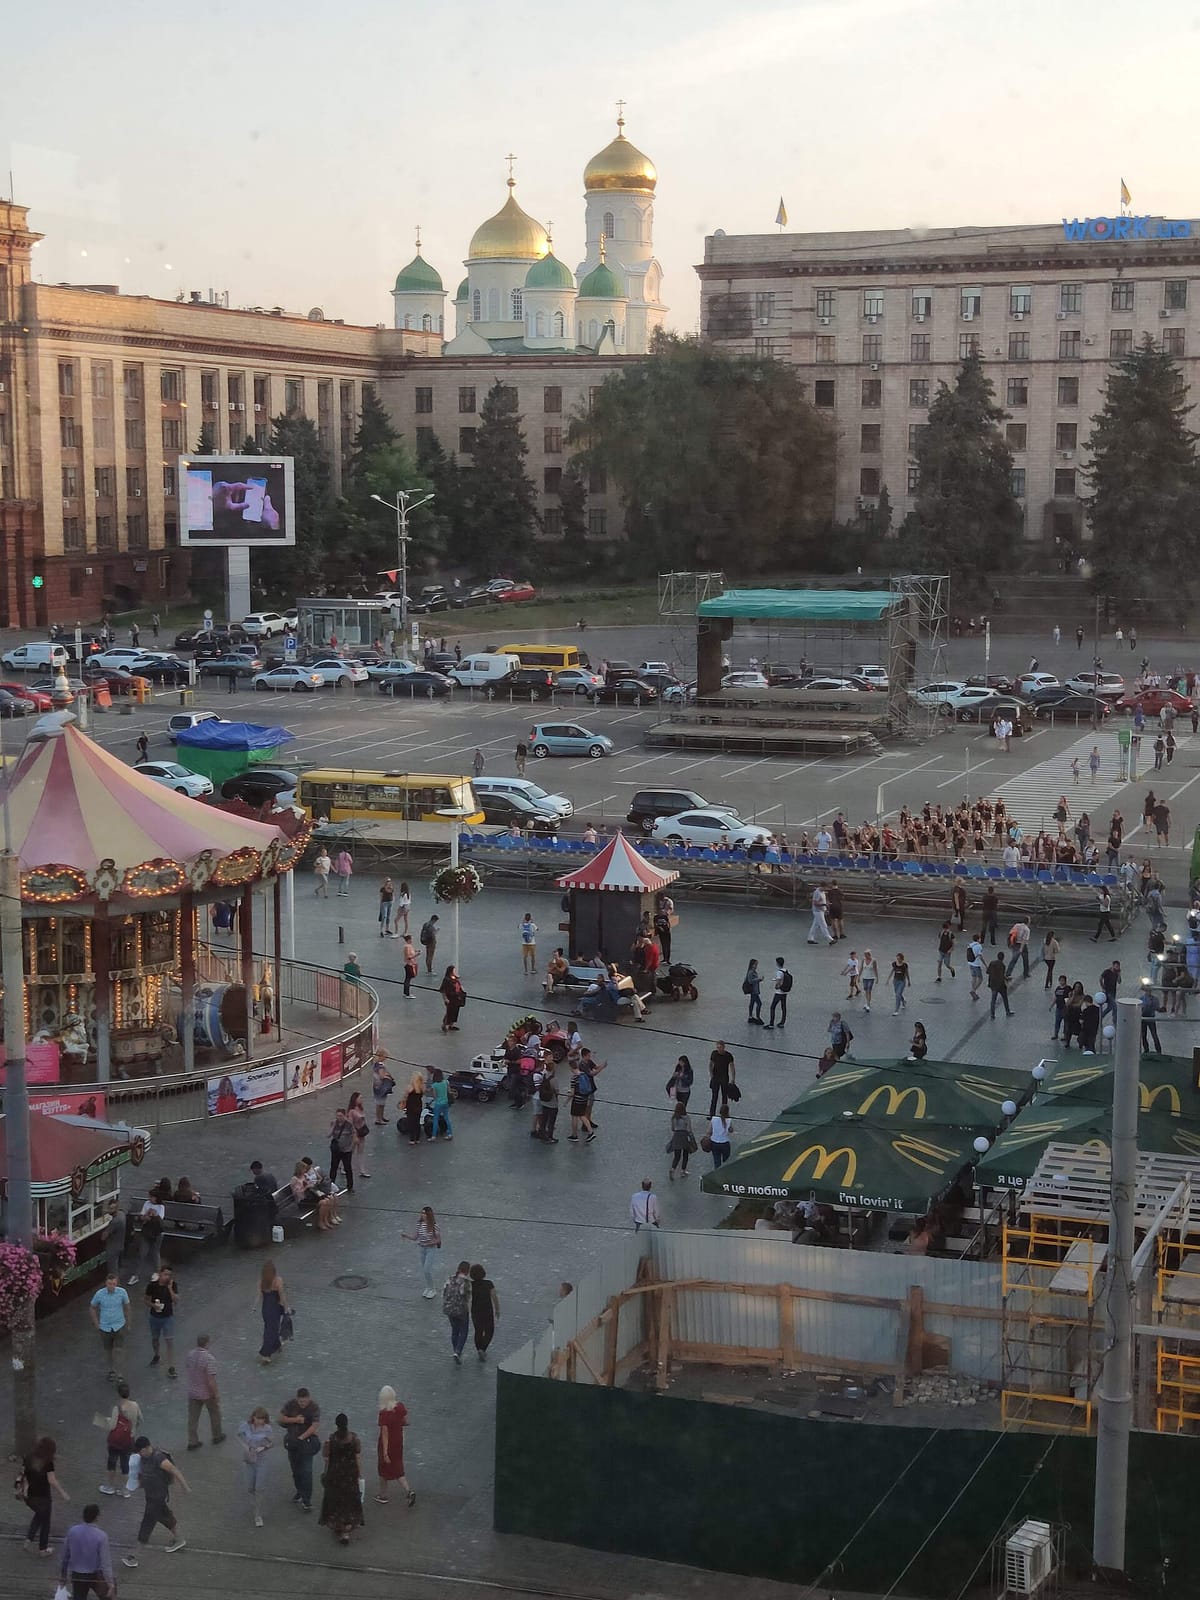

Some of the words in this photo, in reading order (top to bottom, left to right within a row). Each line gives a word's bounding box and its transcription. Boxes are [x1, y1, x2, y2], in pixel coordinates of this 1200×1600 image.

[1007, 1176, 1024, 1187] це
[731, 1184, 746, 1194] це
[747, 1185, 788, 1196] люблю
[860, 1195, 892, 1208] lovin'
[894, 1198, 904, 1210] it
